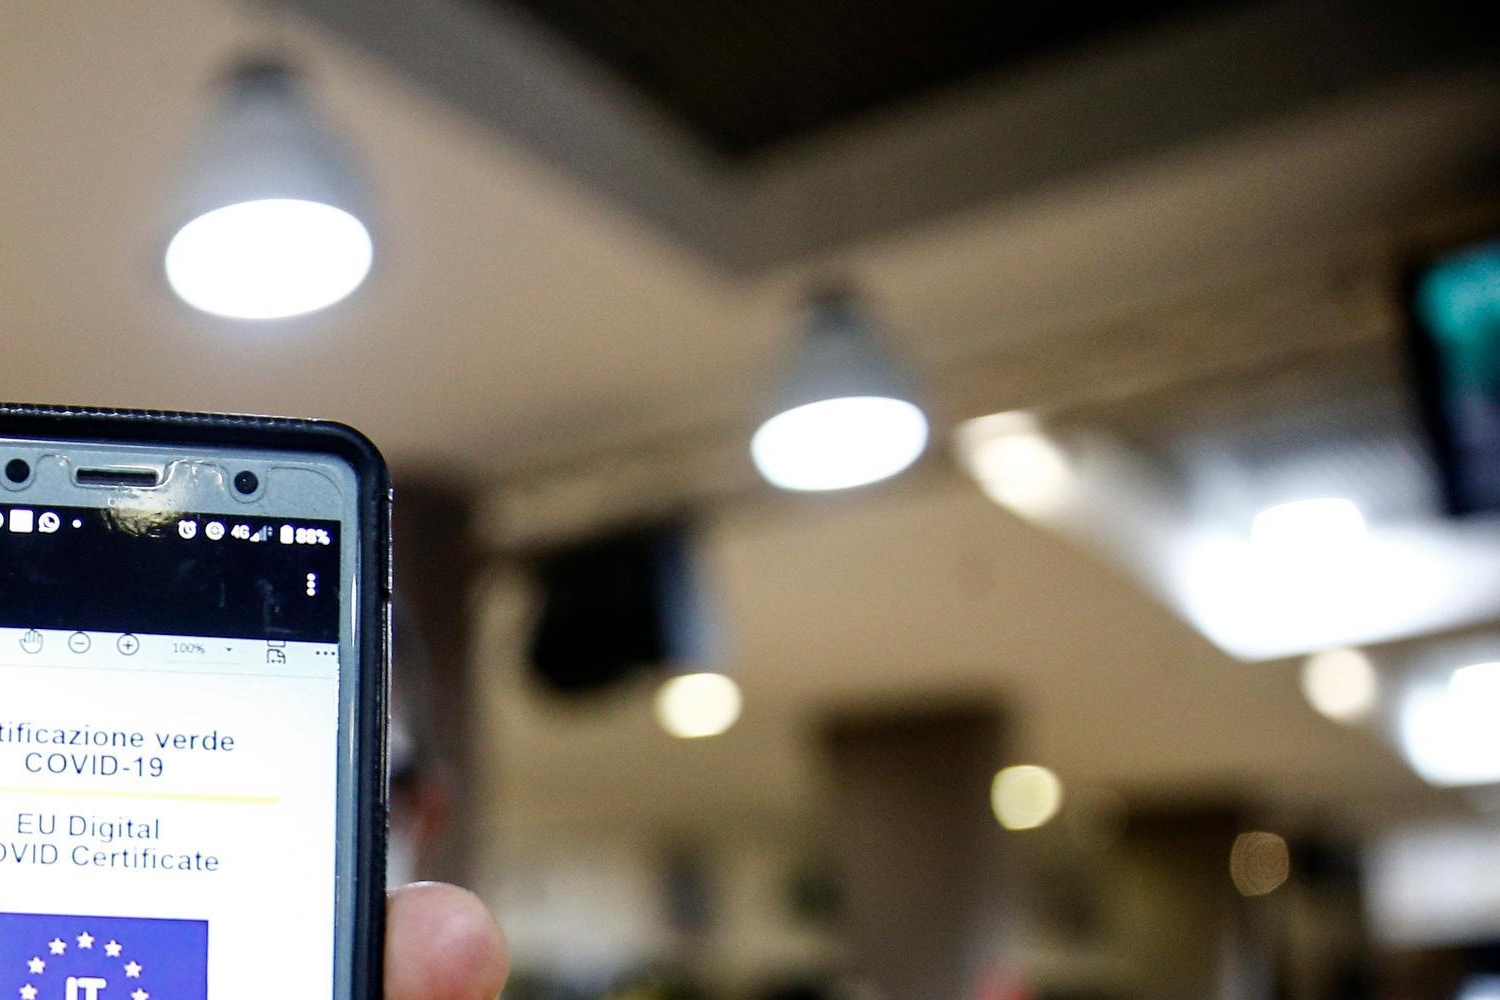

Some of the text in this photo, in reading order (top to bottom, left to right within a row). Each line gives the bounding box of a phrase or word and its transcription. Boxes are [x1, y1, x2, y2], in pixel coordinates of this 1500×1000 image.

[231, 524, 250, 539] 4G
[172, 642, 206, 654] 100%
[156, 730, 235, 752] verde
[24, 752, 164, 778] COVID-19
[17, 813, 160, 843] EU Digital
[71, 846, 219, 872] Certificate
